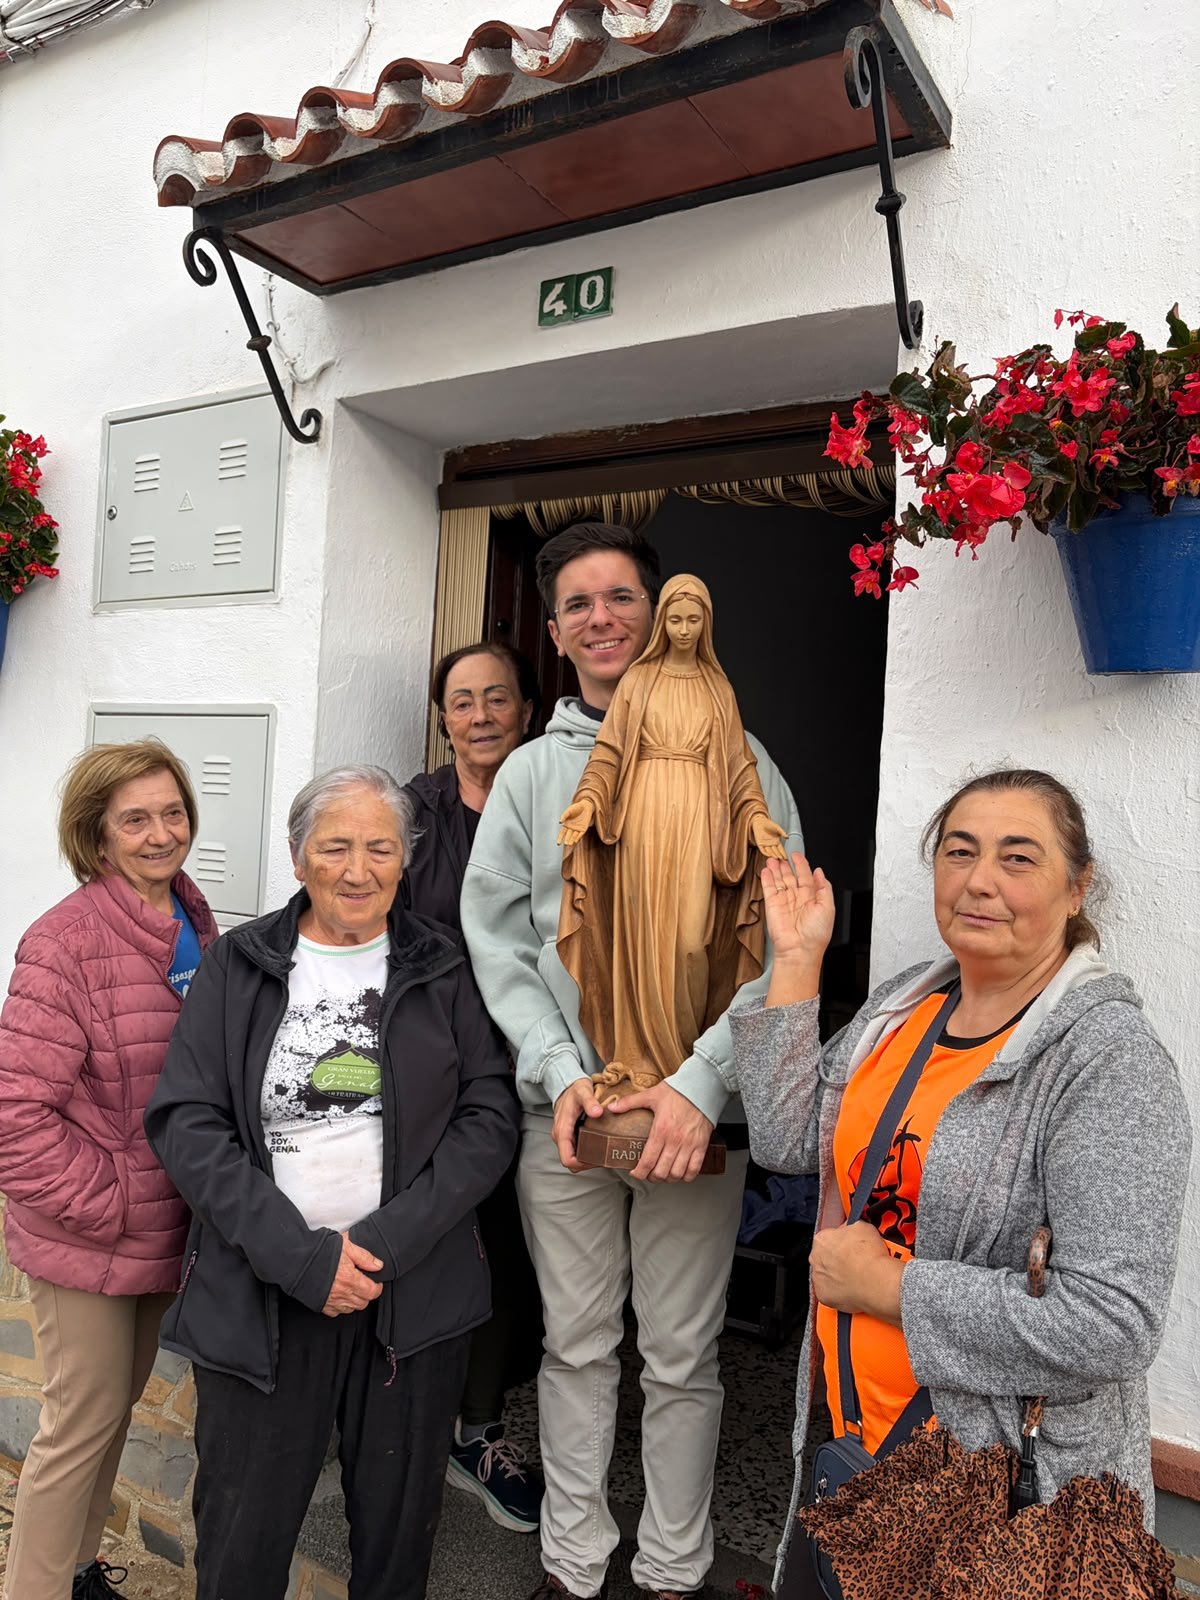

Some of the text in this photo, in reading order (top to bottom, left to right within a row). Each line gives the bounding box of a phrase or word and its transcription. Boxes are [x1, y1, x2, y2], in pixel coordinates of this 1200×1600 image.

[543, 275, 605, 317] 40
[315, 1073, 381, 1090] Genal
[269, 1145, 301, 1153] GENAL
[629, 1141, 643, 1150] RE
[611, 1149, 641, 1161] RADI
